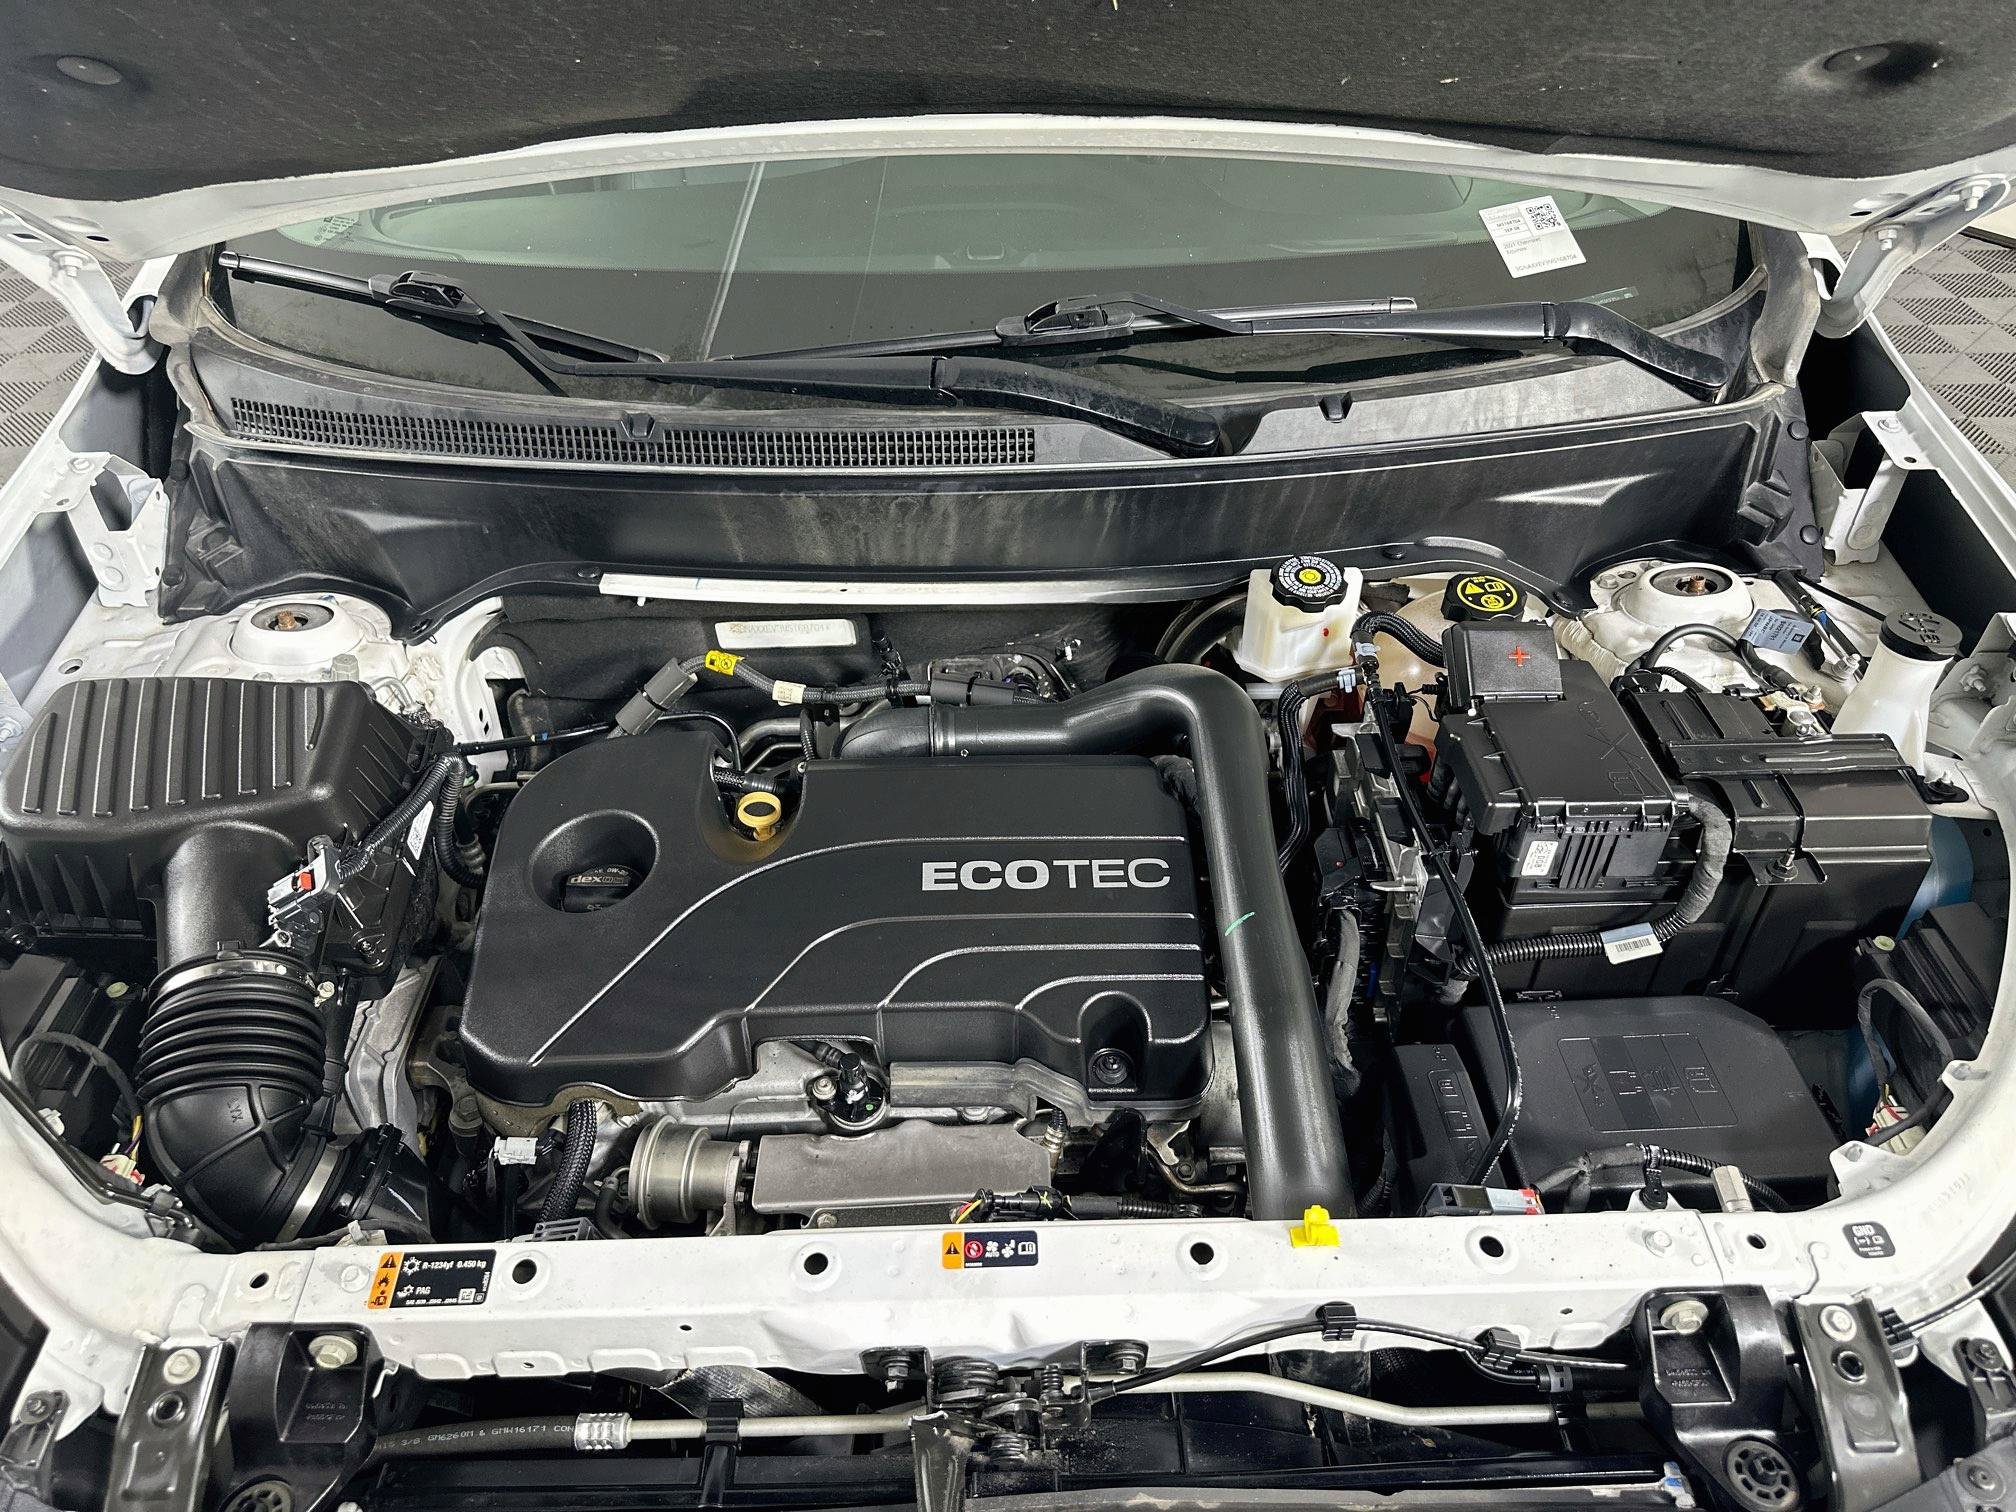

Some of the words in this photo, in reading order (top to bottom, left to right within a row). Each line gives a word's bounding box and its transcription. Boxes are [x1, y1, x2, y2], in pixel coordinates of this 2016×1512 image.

[921, 857, 1171, 891] ECOTEC
[1851, 1224, 1875, 1236] GND
[422, 1260, 454, 1271] R-1234yf
[477, 1260, 487, 1269] kg
[415, 1286, 432, 1295] PAG
[479, 1428, 486, 1437] &
